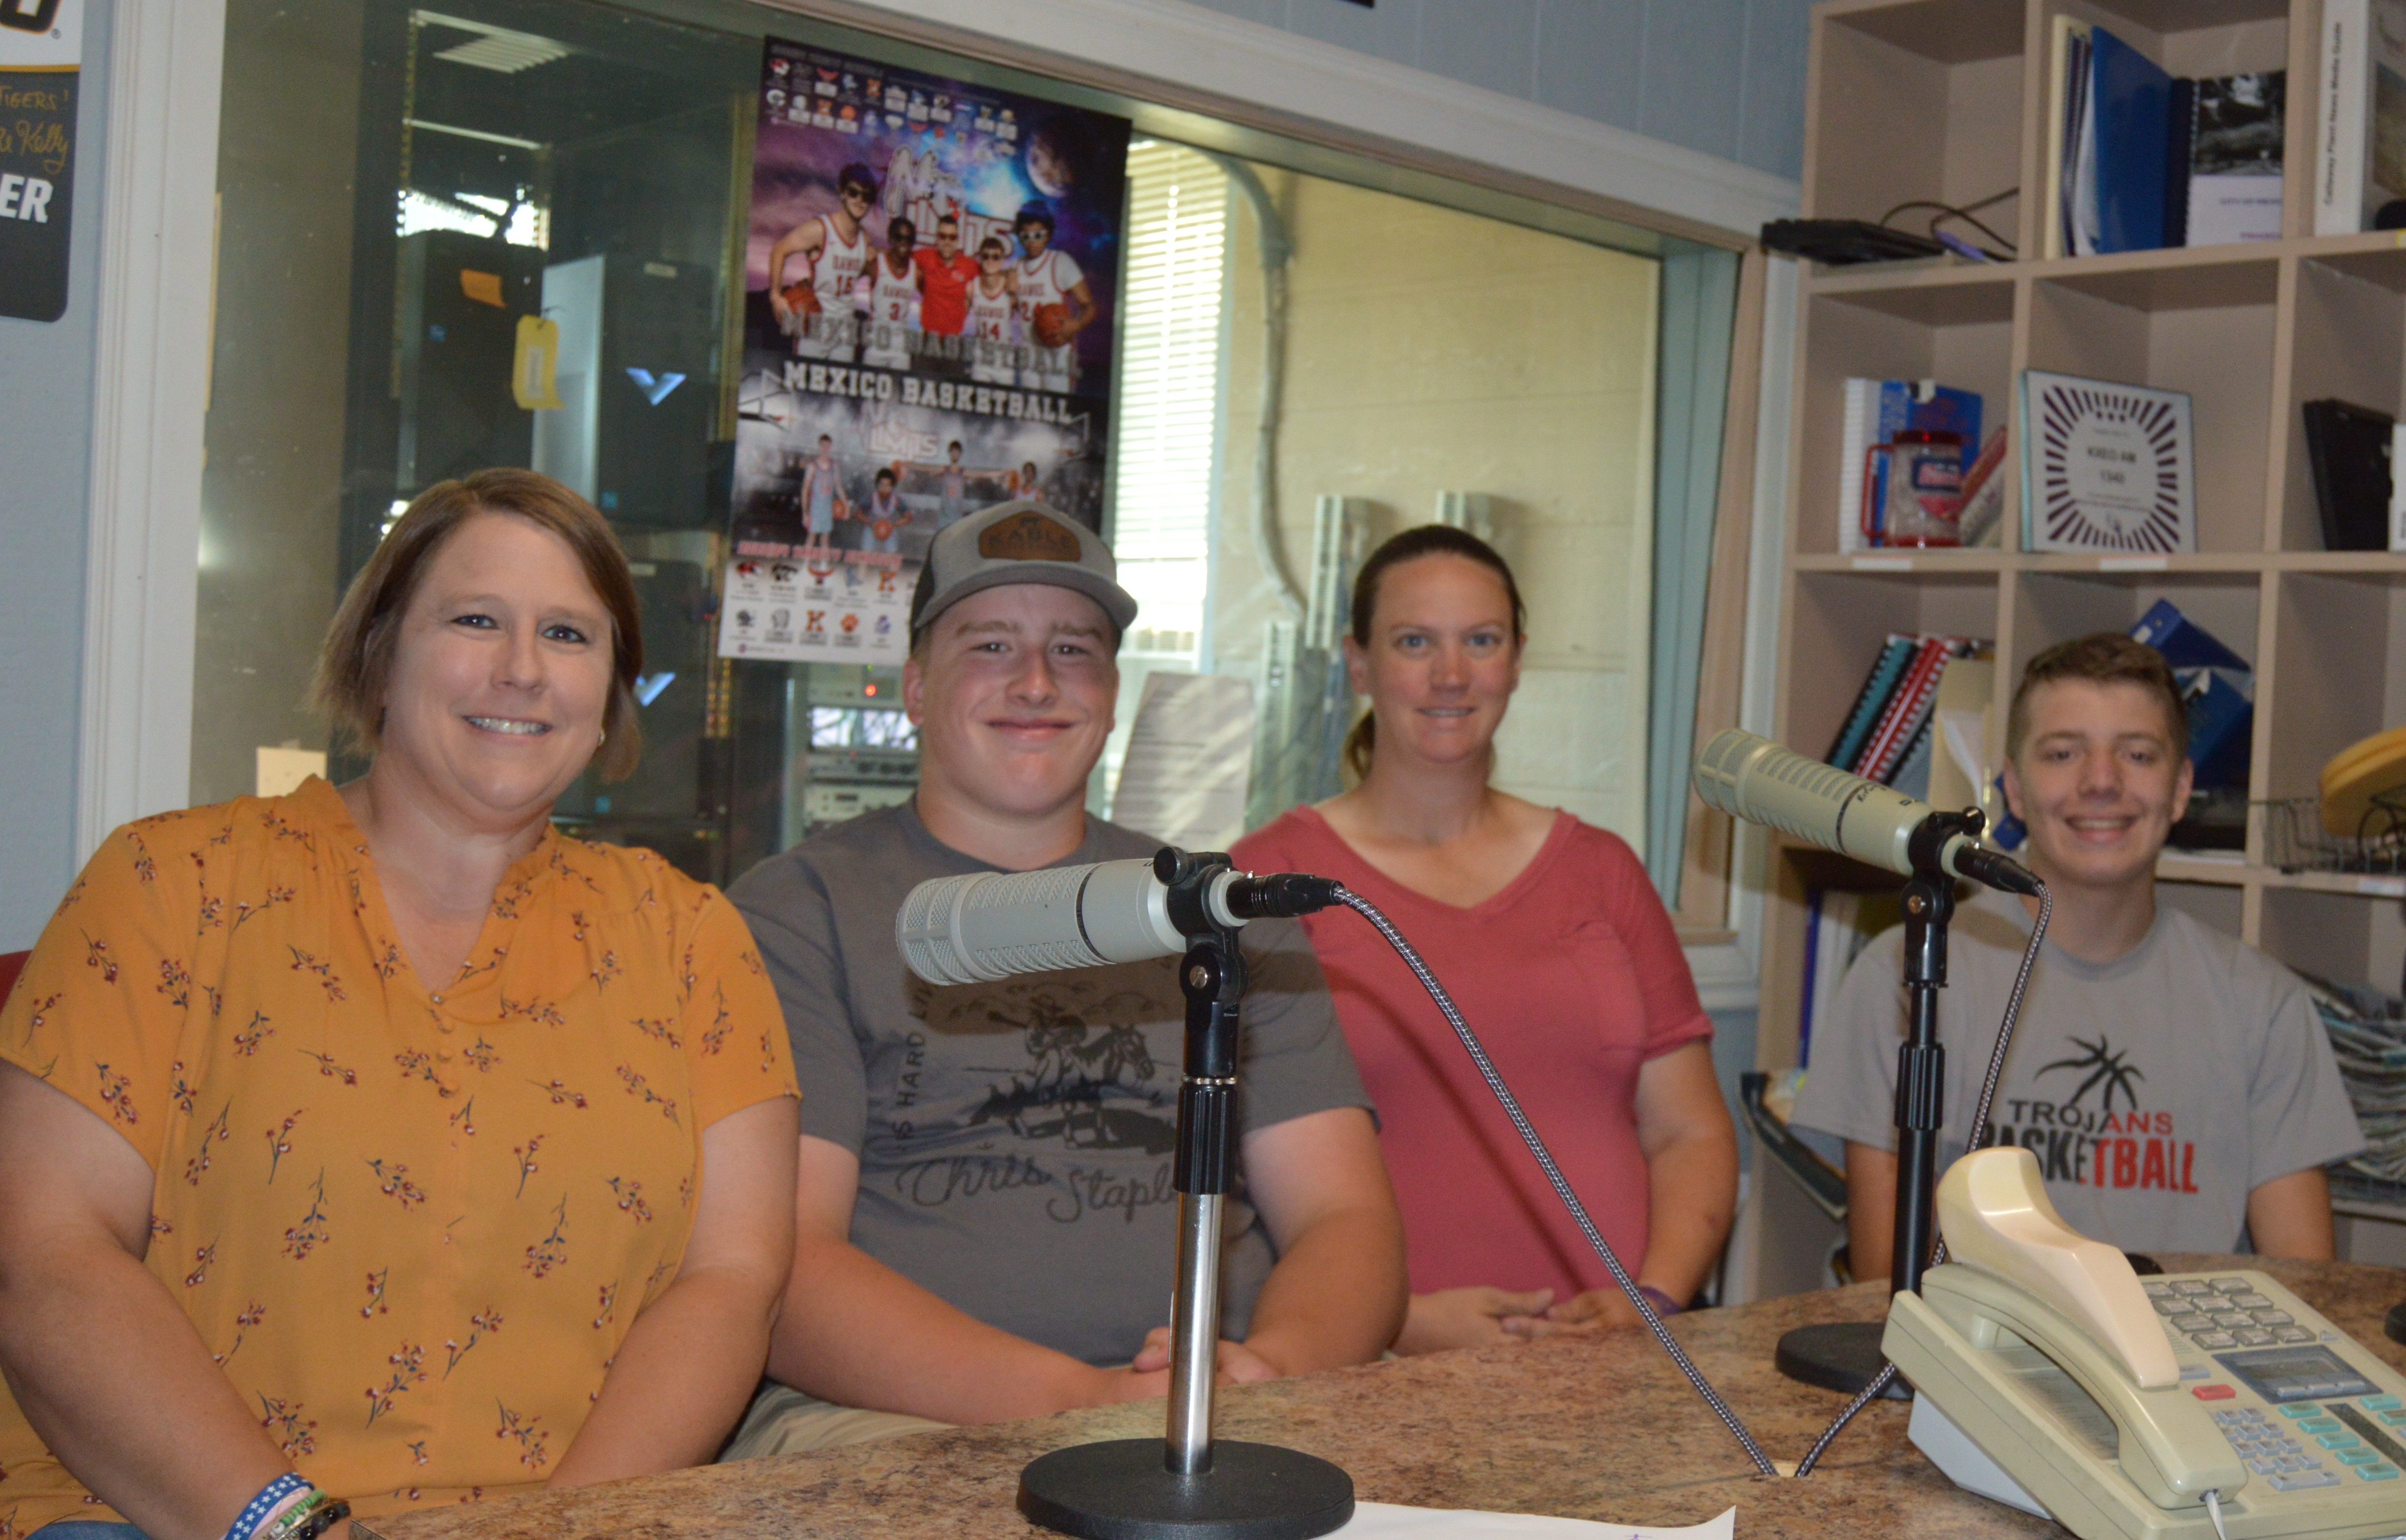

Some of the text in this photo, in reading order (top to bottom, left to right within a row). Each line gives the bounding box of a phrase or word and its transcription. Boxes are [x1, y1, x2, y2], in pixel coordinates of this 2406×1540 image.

[783, 360, 1073, 425] MEXICO BASKETBALL
[895, 1031, 926, 1108] HARD
[2008, 1098, 2173, 1135] TROJANS
